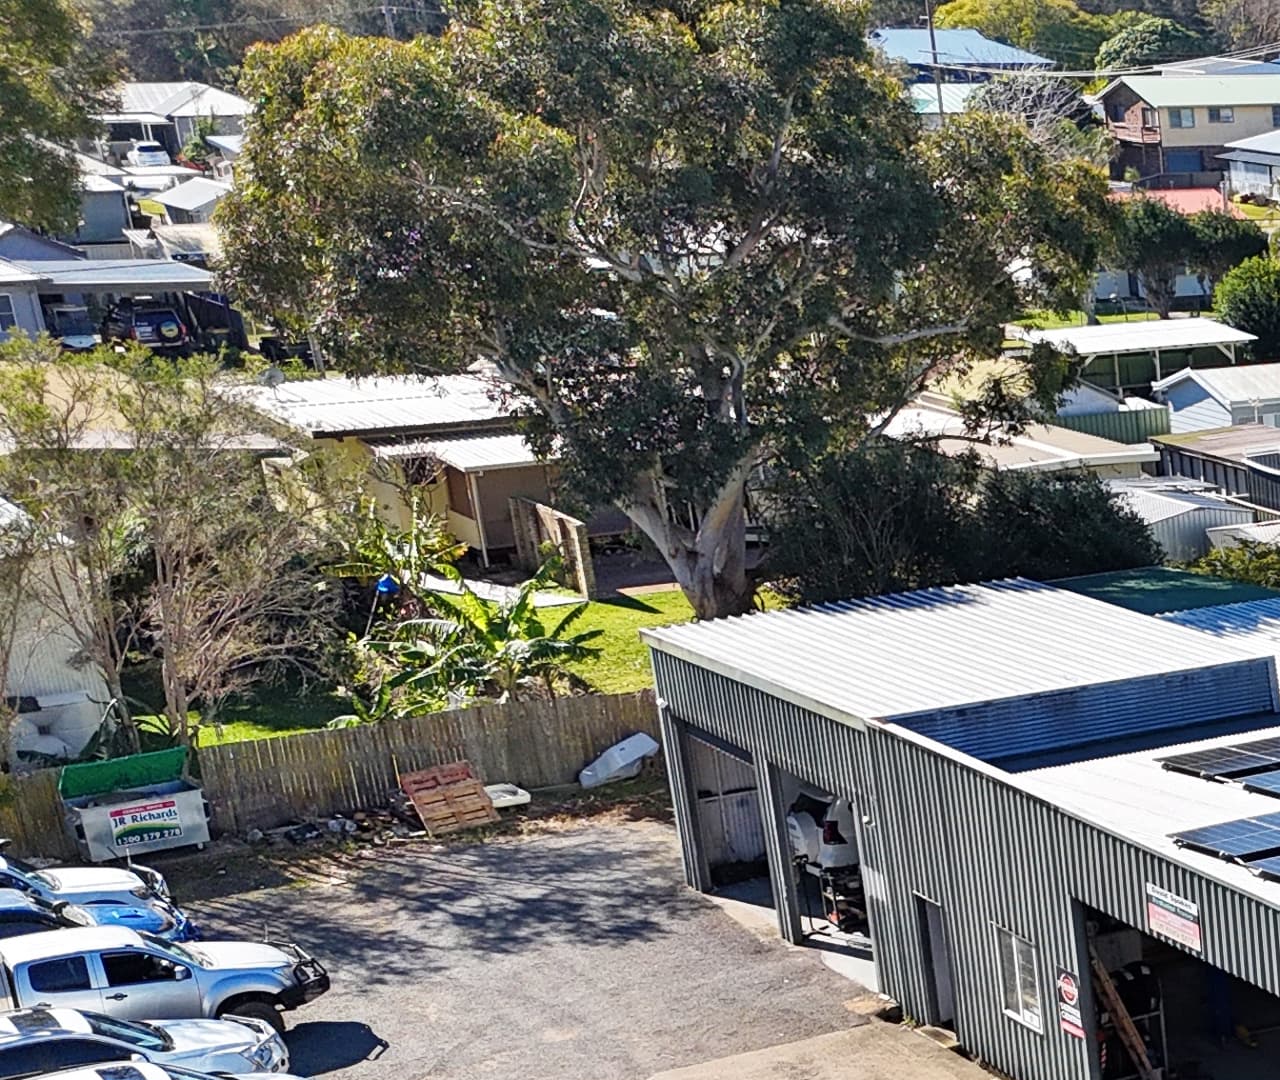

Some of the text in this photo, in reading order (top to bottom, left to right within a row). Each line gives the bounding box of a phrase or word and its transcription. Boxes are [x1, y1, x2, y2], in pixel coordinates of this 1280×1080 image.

[112, 808, 178, 828] JR Richards
[117, 835, 140, 845] 1300
